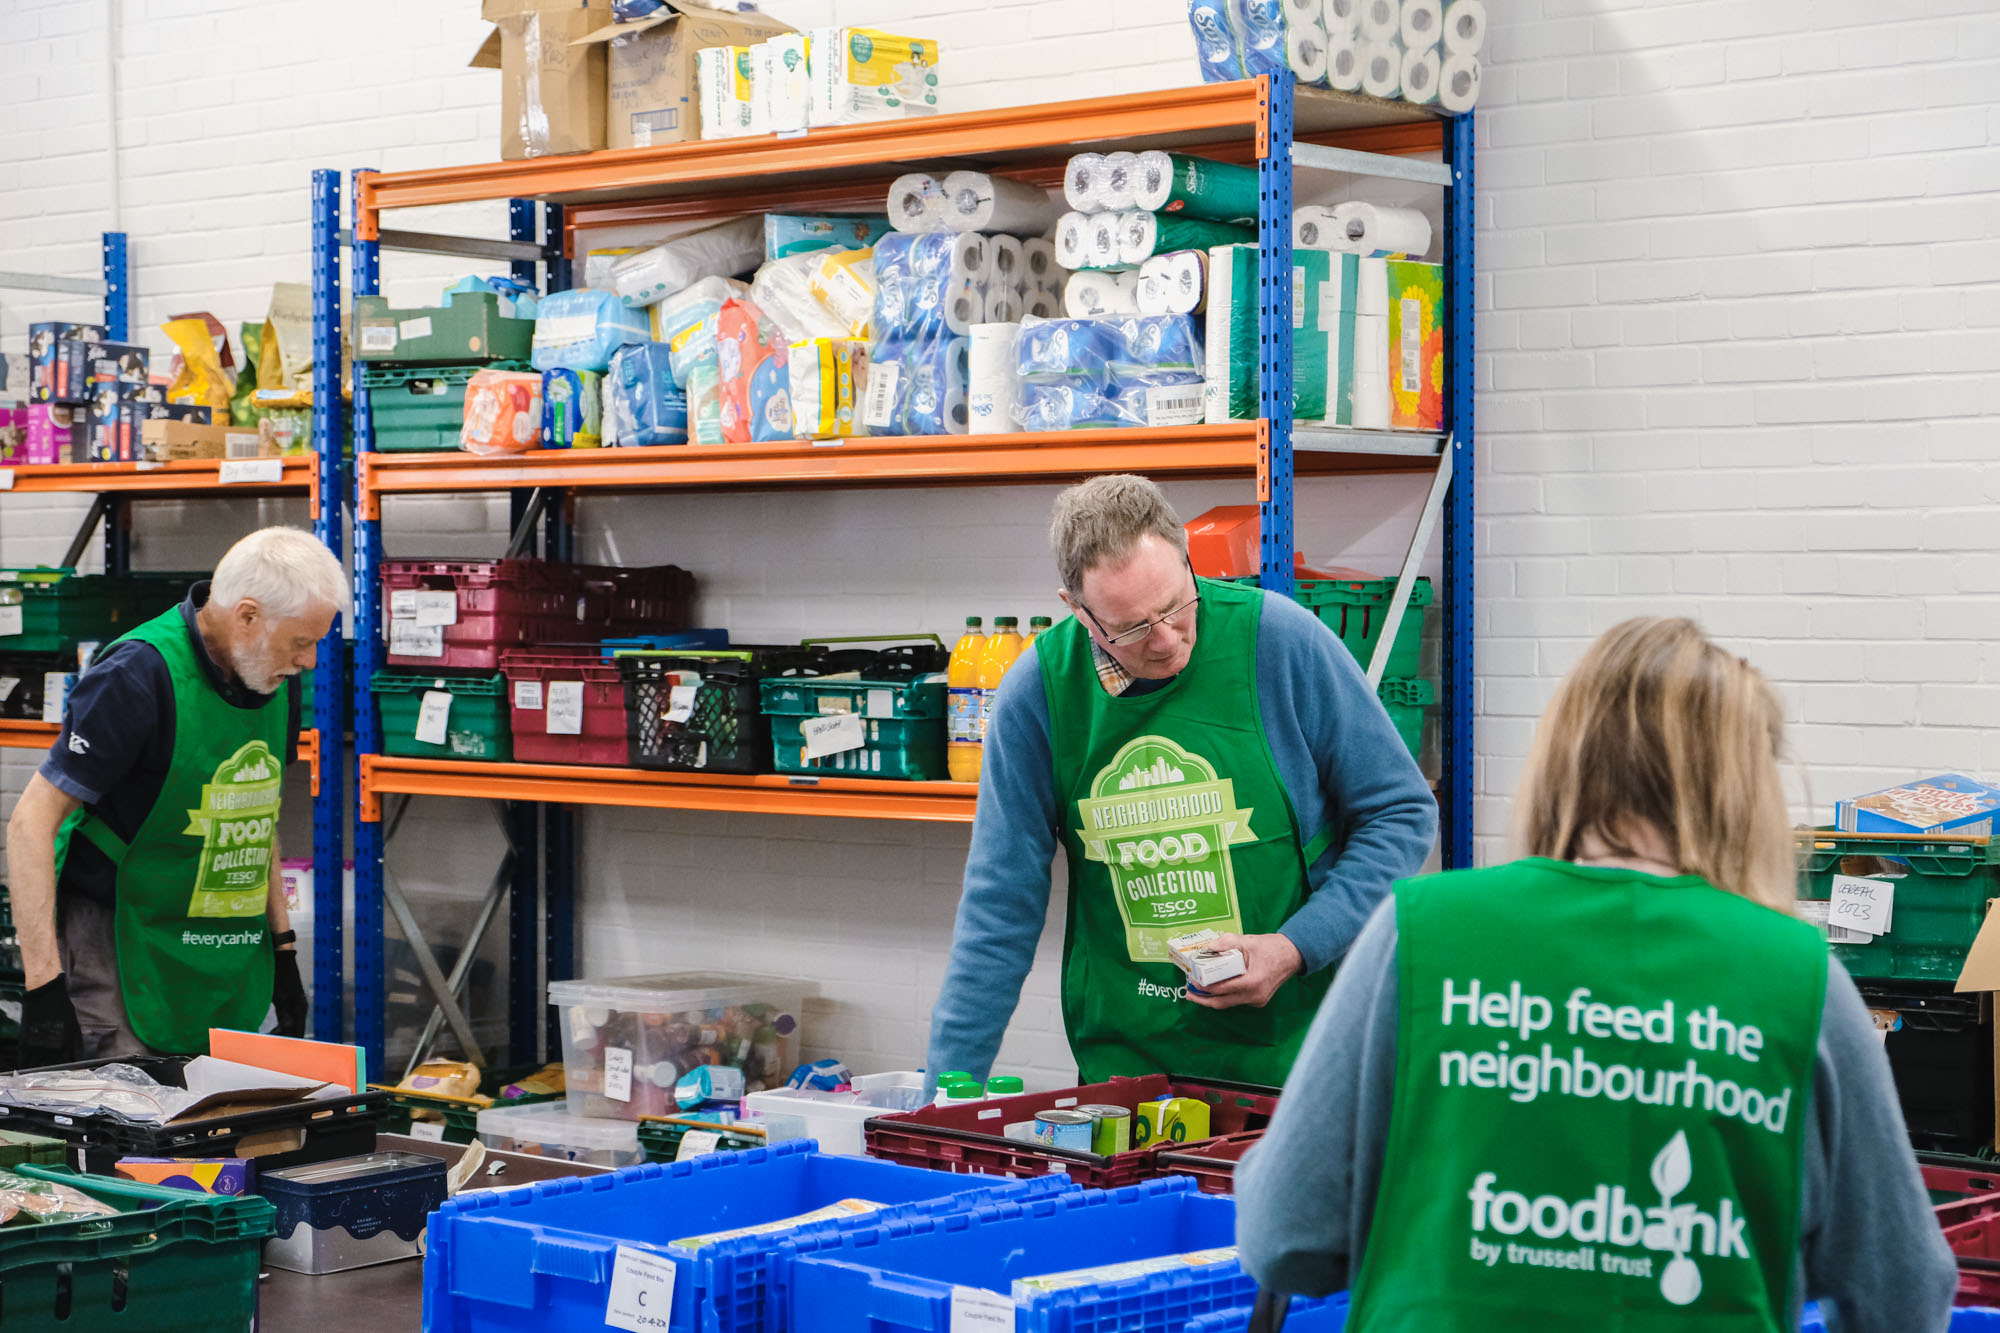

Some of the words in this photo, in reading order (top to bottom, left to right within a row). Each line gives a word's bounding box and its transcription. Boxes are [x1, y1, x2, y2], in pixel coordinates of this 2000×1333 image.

[1092, 791, 1223, 830] NEIGHBOURHOOD
[1920, 788, 1974, 802] malt
[218, 818, 272, 845] FOOD
[1117, 832, 1209, 868] FOOD
[1127, 870, 1218, 902] COLLECTION
[1152, 899, 1197, 914] TESCO
[1838, 899, 1872, 921] 2023
[1441, 978, 1552, 1041] Help
[1565, 987, 1674, 1043] feed
[1687, 1006, 1764, 1062] the
[1439, 1041, 1791, 1133] neighbourhood
[1468, 1172, 1750, 1259] foodbank
[1470, 1237, 1502, 1266] by
[1507, 1243, 1595, 1271] trussell
[1601, 1252, 1652, 1278] trust
